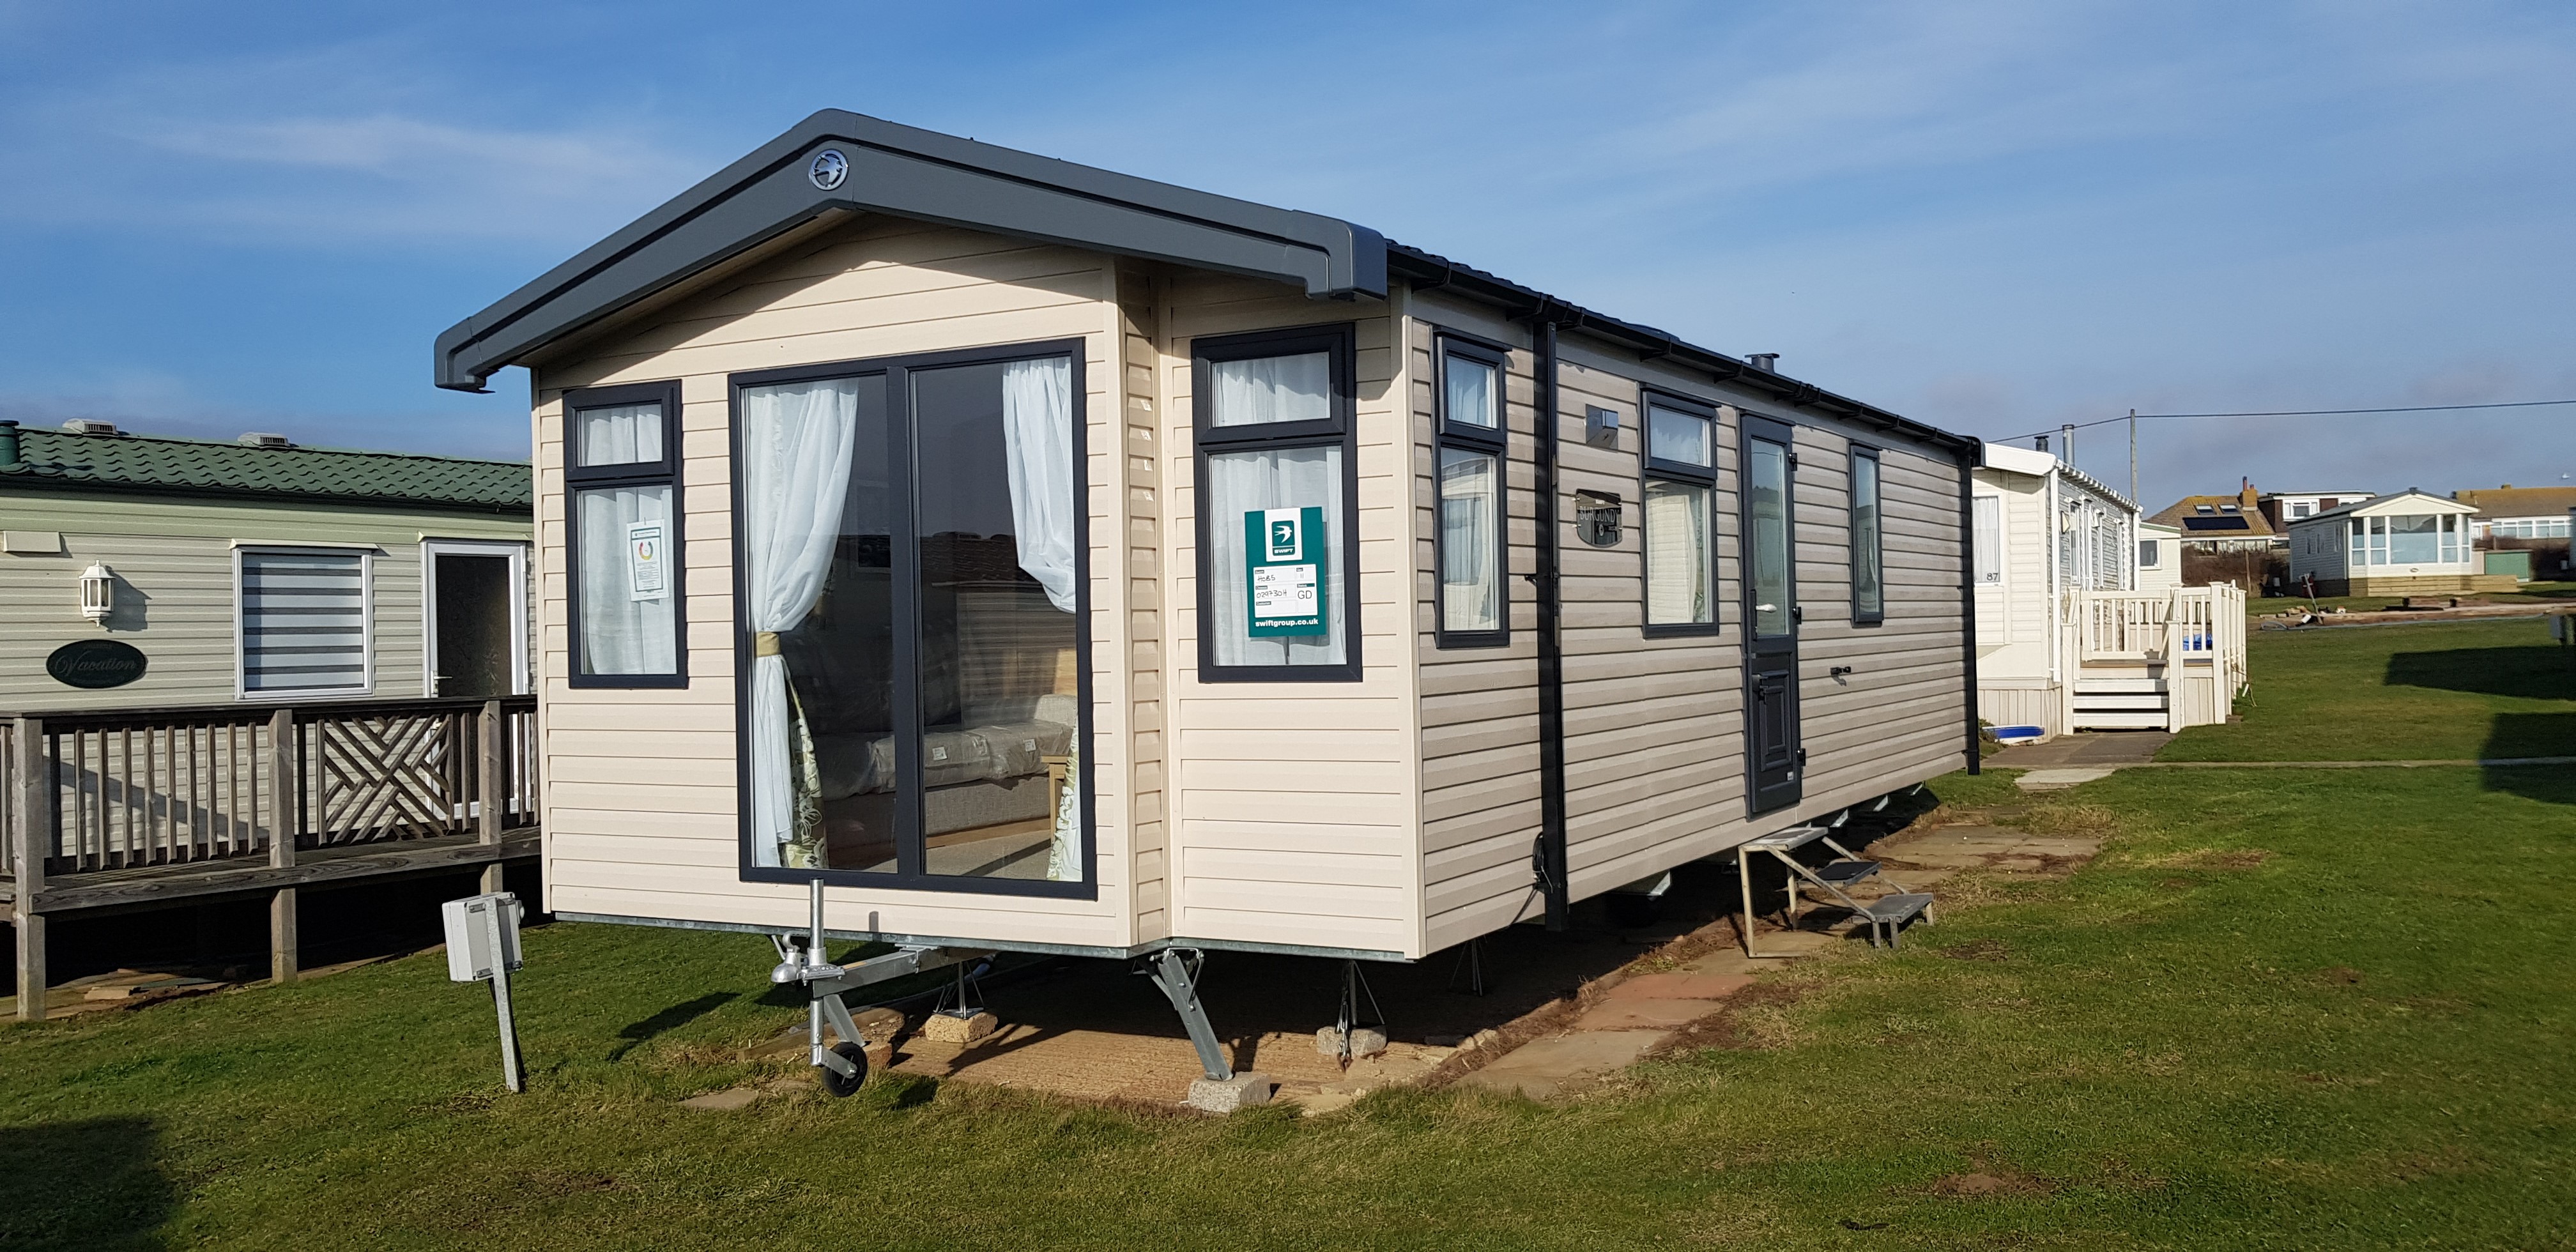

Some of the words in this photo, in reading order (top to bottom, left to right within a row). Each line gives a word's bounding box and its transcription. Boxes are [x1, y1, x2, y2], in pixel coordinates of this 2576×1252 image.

[1580, 506, 1619, 523] BURGUNDY
[1987, 572, 1998, 581] 87
[1298, 590, 1312, 599] GD
[1255, 618, 1318, 627] swiftgroup.co.uk
[55, 650, 136, 676] Vacation
